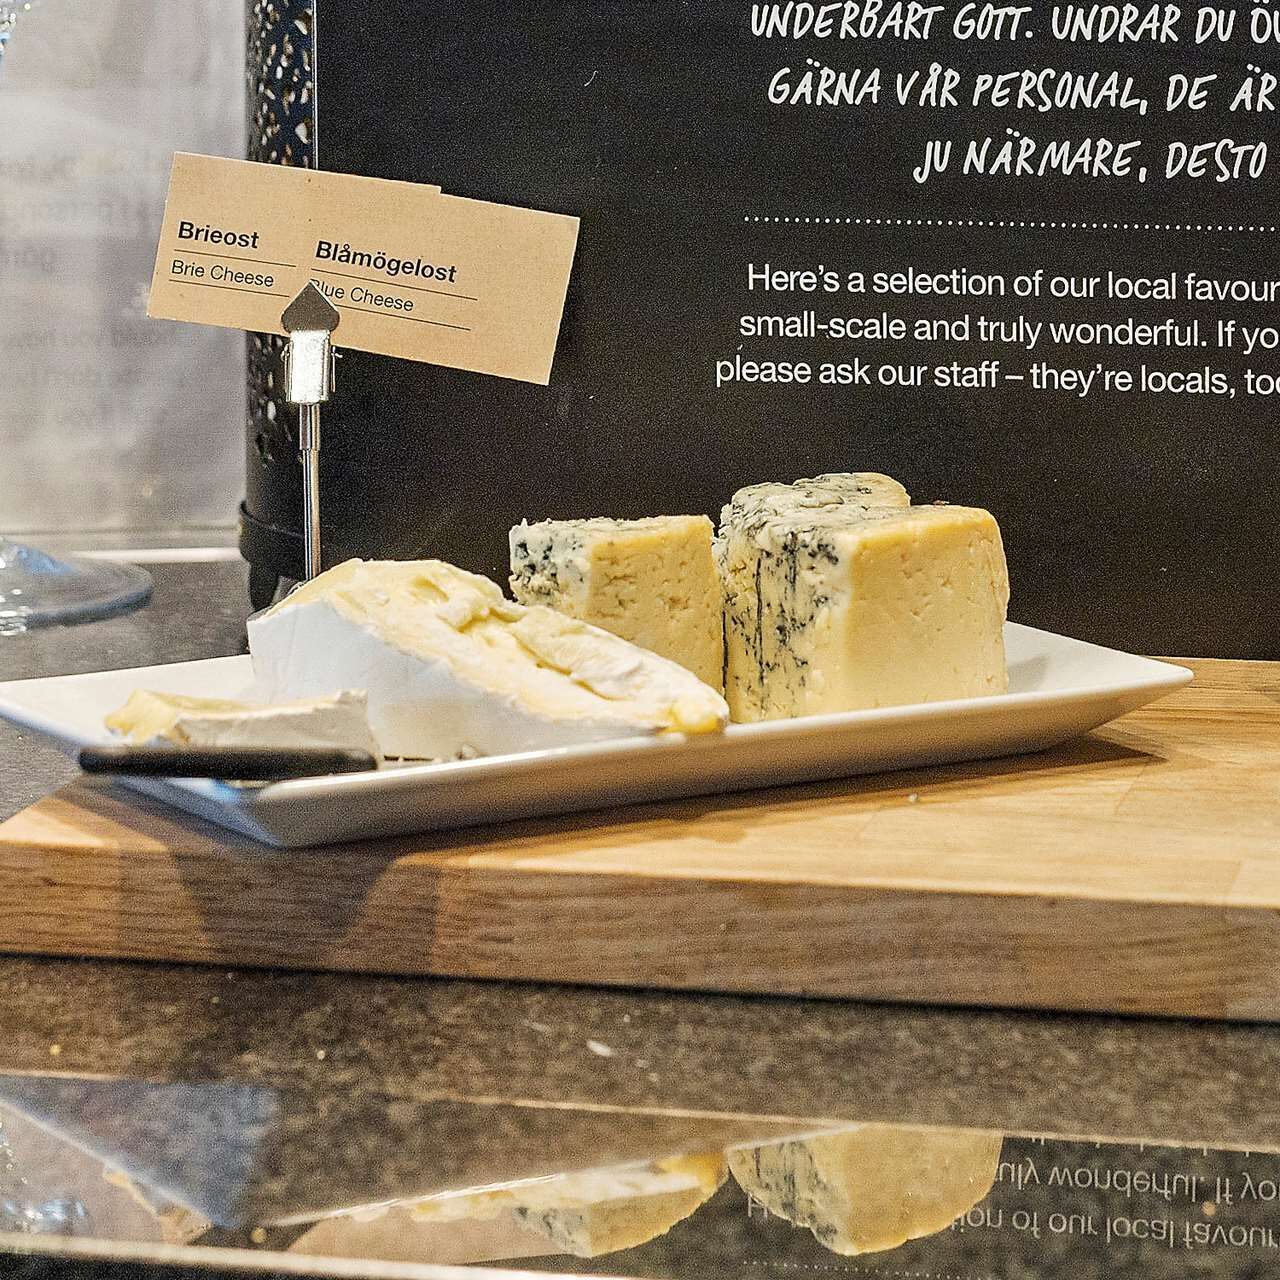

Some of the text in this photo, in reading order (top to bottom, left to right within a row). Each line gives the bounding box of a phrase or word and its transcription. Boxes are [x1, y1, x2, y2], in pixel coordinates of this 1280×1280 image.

[953, 3, 1033, 40] GOTT.
[1052, 3, 1181, 43] UNDRAR
[1196, 7, 1236, 44] DU
[768, 58, 881, 105] GÄRNA
[897, 62, 960, 107] VÅR
[973, 68, 1147, 115] PERSONAL,
[1167, 74, 1217, 111] DE
[1230, 64, 1277, 112] ÄR
[913, 141, 951, 183] JU
[963, 128, 1147, 182] NÄRMARE,
[1166, 139, 1267, 182] DESTO
[177, 220, 259, 250] Brieost
[172, 259, 275, 288] Brie Cheese
[315, 240, 457, 284] Blåmögelost
[749, 264, 839, 292] Here’s
[848, 273, 865, 292] a
[873, 267, 1004, 295] selection
[1014, 270, 1043, 296] of
[1050, 277, 1100, 297] our
[1109, 271, 1176, 299] local
[350, 286, 414, 312] Cheese
[740, 311, 906, 339] small-scale
[914, 315, 969, 340] and
[977, 316, 1042, 349] truly
[1050, 318, 1206, 346] wonderful.
[1218, 320, 1235, 347] If
[717, 355, 811, 387] please
[819, 358, 870, 384] ask
[878, 365, 927, 385] our
[935, 361, 999, 387] staff
[1030, 362, 1132, 397] they’re
[1142, 365, 1235, 398] locals,
